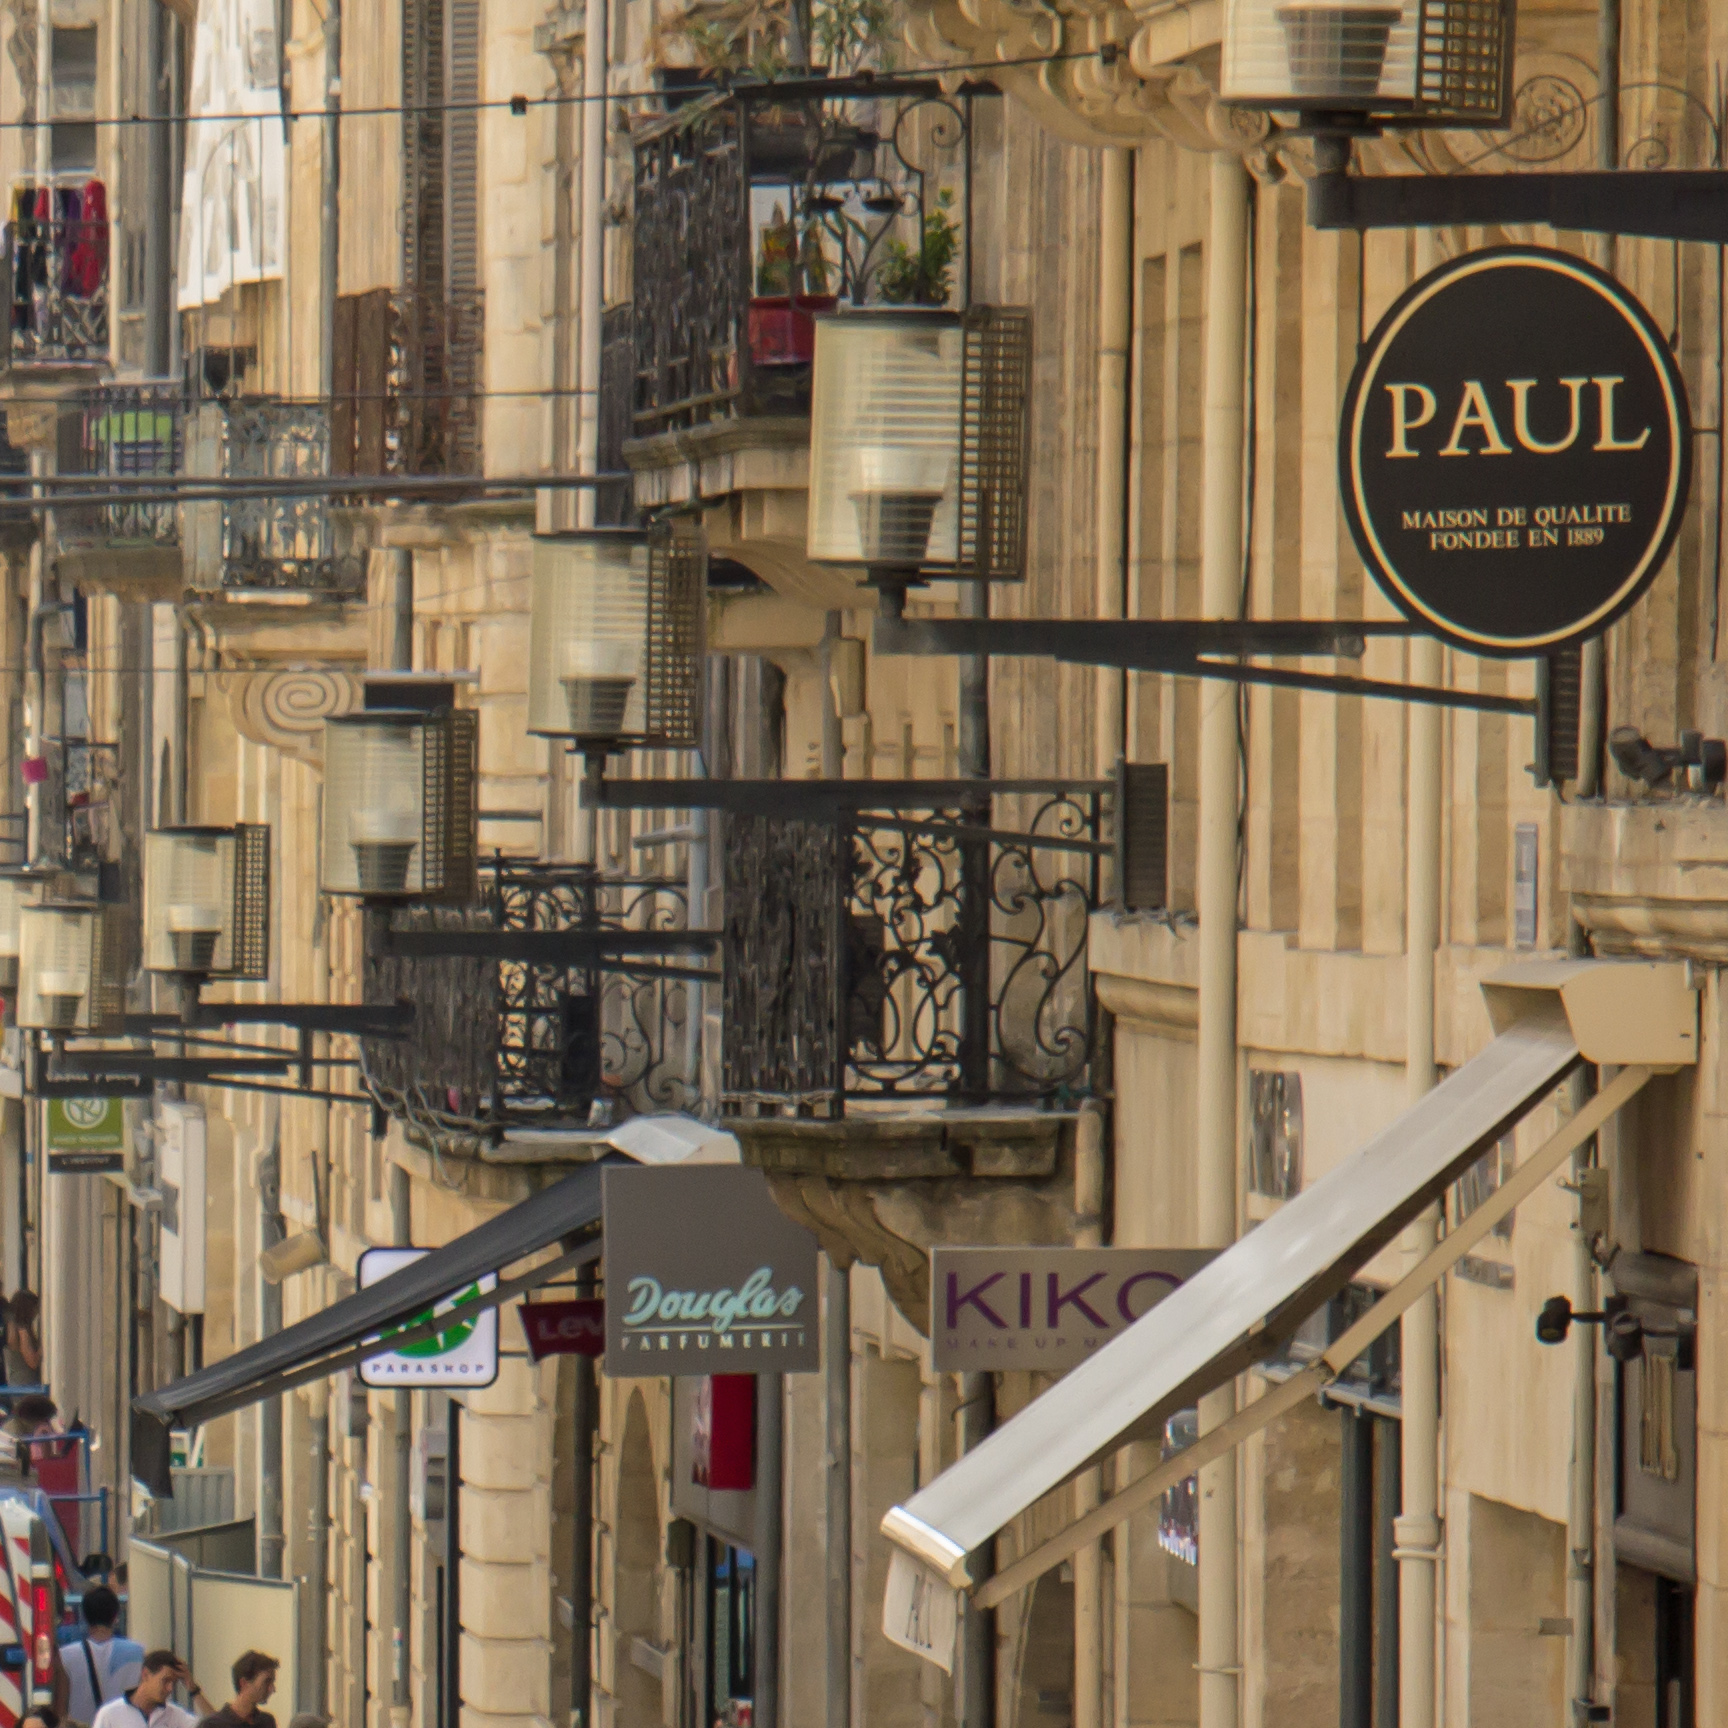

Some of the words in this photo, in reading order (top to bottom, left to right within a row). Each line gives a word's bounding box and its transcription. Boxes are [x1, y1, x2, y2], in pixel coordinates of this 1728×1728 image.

[1385, 375, 1651, 458] PAUL
[1402, 508, 1488, 529] MAISON
[1497, 507, 1527, 526] DE
[1529, 528, 1558, 547] EN
[1568, 527, 1604, 546] 1889
[622, 1266, 805, 1333] Douglas
[947, 1338, 1017, 1348] MAKE
[1034, 1337, 1066, 1348] UP
[373, 1363, 484, 1373] PARASHOP
